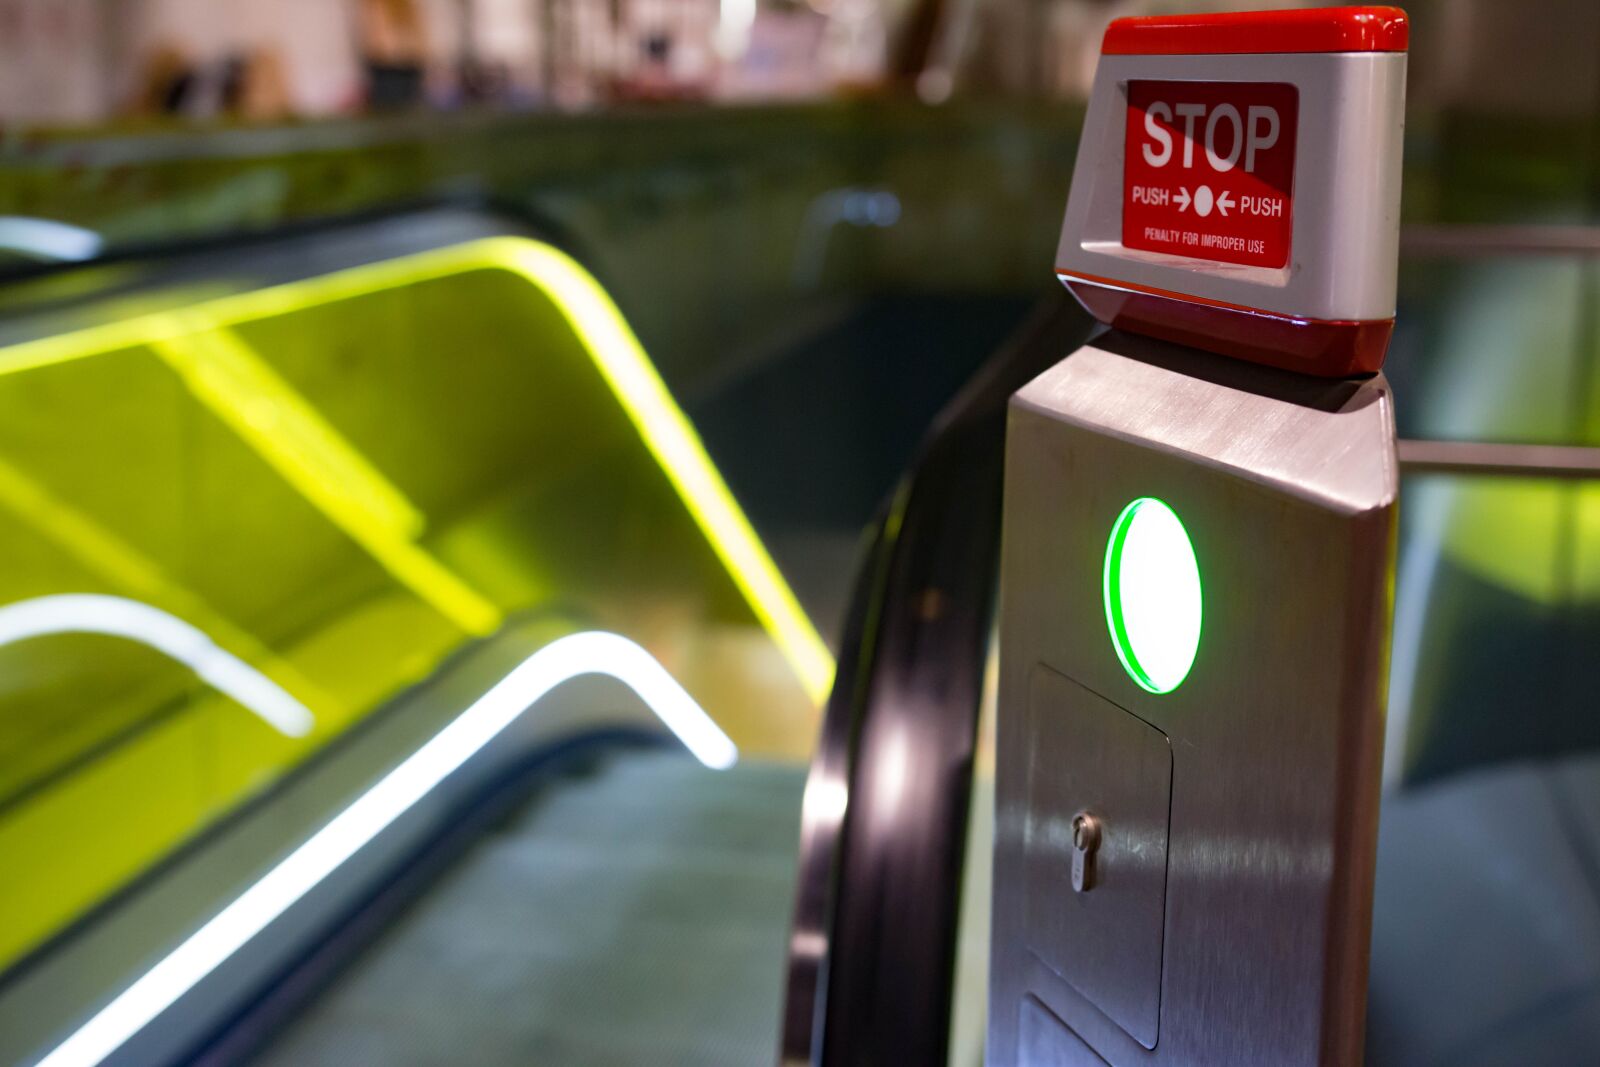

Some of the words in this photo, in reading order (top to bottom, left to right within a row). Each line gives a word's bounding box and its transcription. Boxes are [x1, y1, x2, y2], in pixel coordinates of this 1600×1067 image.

[1142, 101, 1280, 173] STOP
[1132, 185, 1169, 206] PUSH
[1241, 195, 1282, 217] PUSH
[1144, 227, 1180, 243] PENALTY
[1182, 231, 1199, 246] FOR
[1201, 234, 1245, 251] IMPROPER
[1248, 239, 1265, 254] USE
